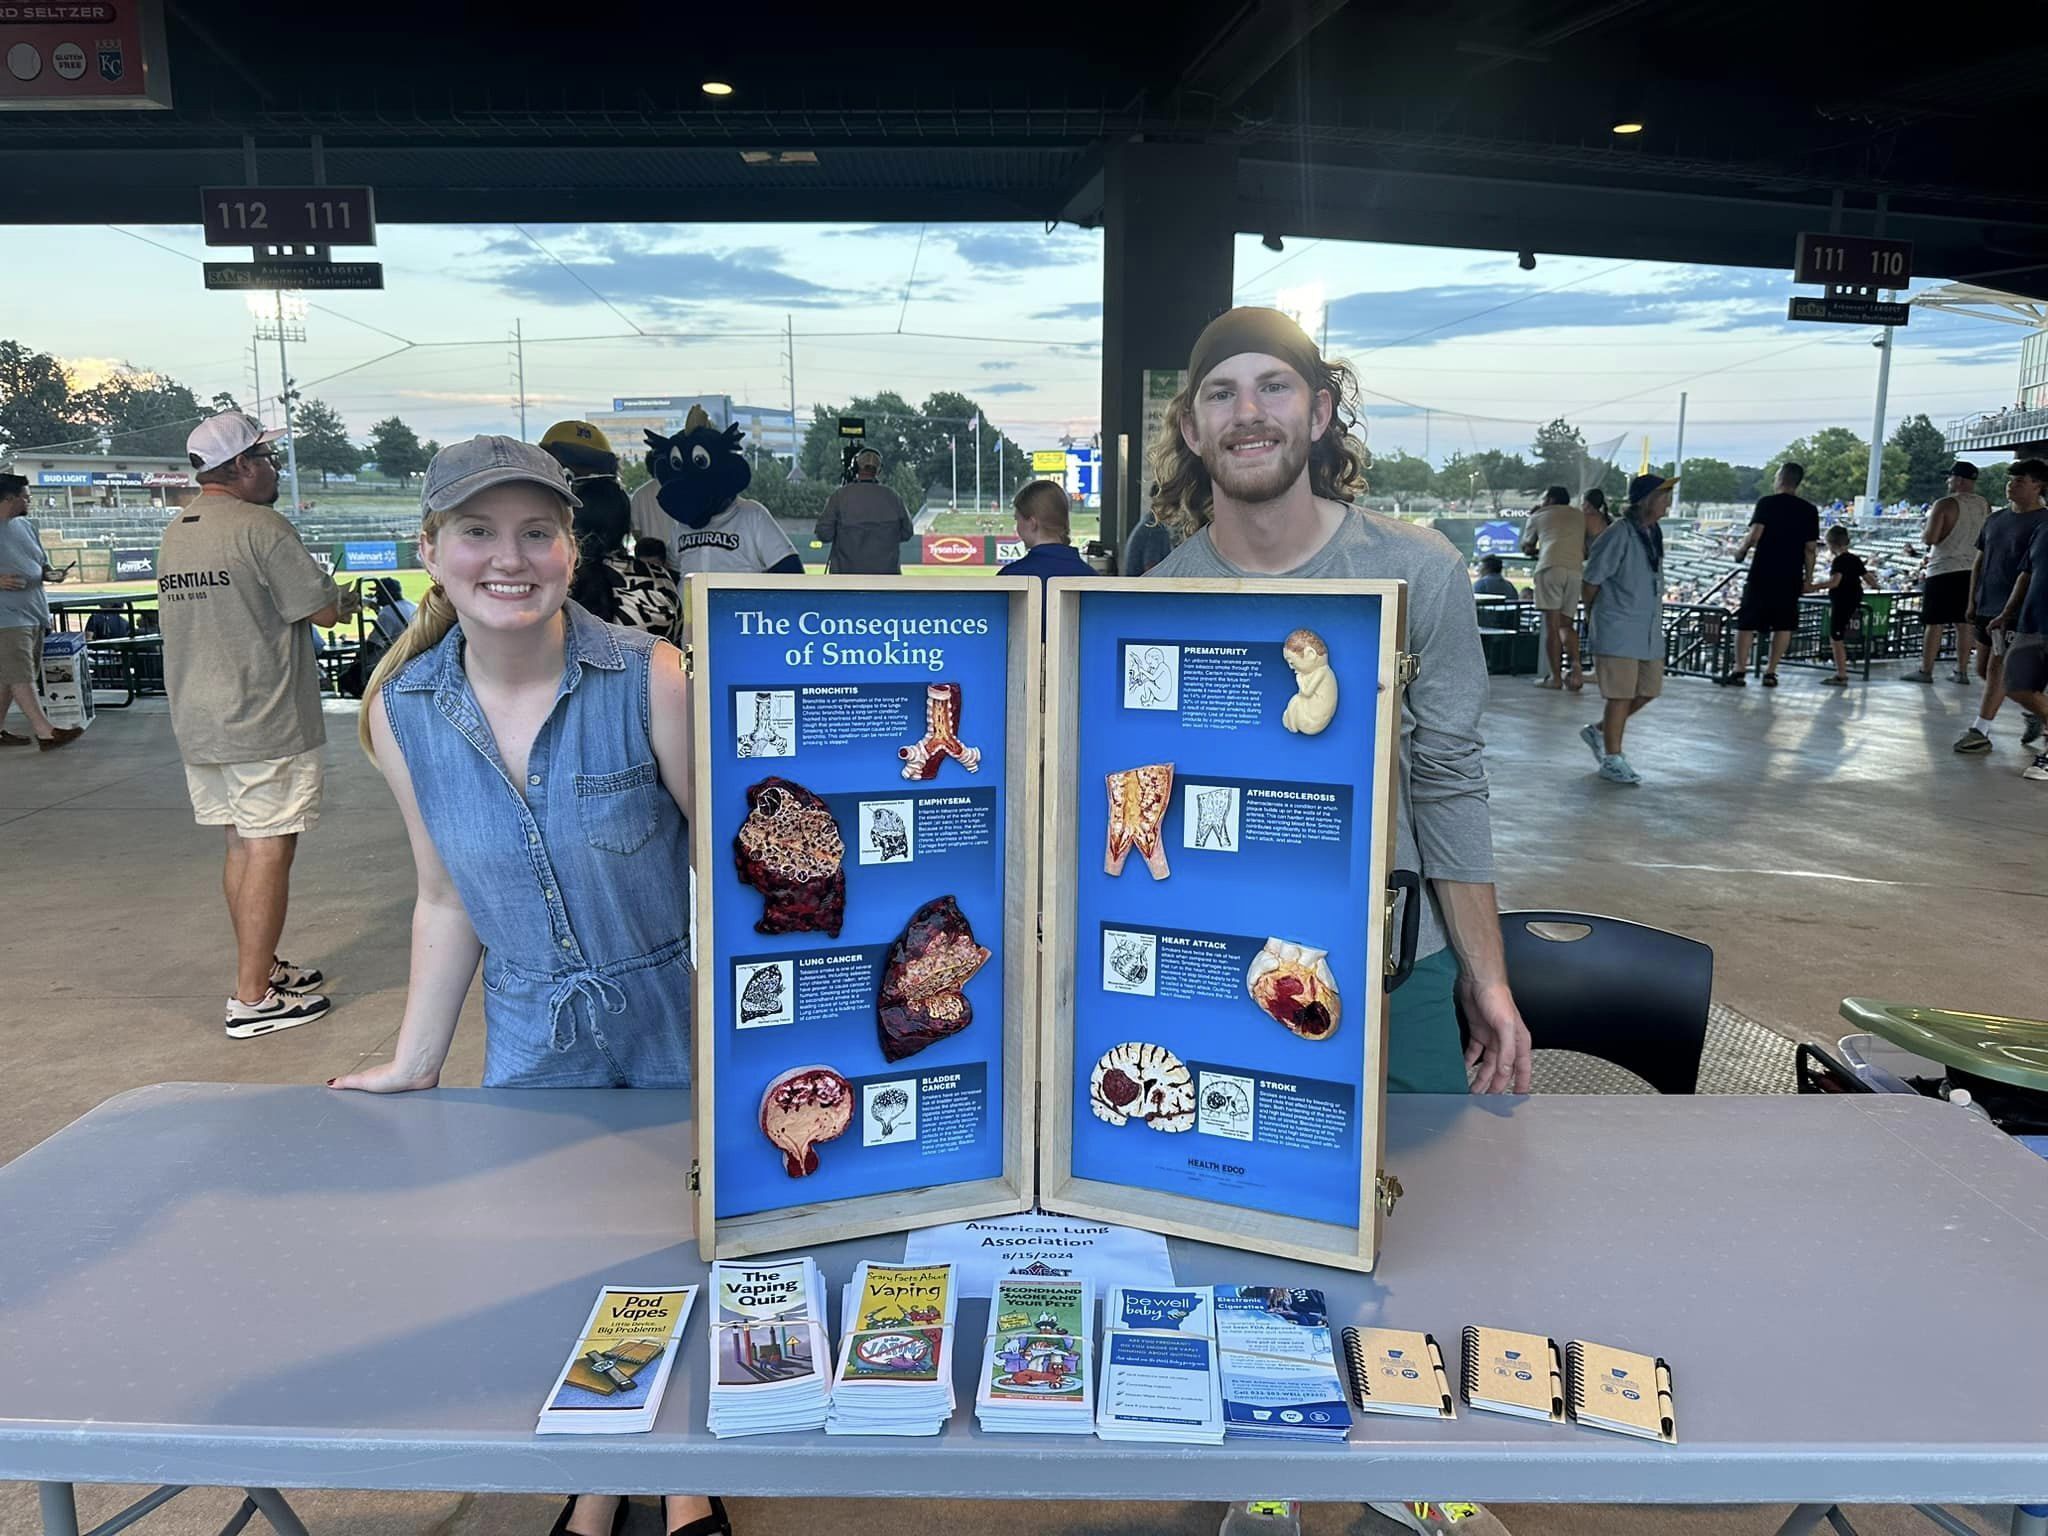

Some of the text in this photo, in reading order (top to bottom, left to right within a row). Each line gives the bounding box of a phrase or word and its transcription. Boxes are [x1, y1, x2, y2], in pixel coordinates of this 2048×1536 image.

[24, 7, 104, 18] SELTZER
[101, 55, 121, 75] KC
[217, 202, 351, 229] 112 111
[1814, 247, 1903, 275] 111 110
[43, 474, 87, 483] BUD LIGHT
[348, 552, 383, 561] Walmart
[735, 611, 988, 642] The Consequences
[785, 641, 944, 671] of Smoking
[1184, 647, 1248, 655] PREMATURITY
[802, 687, 858, 695] BRONCHITIS
[919, 797, 971, 806] EMPHYSEMA
[1247, 789, 1336, 802] ATHEROSCLEROSIS
[1161, 936, 1227, 950] HEART ATTACK
[800, 955, 863, 966] LUNG CANCER
[922, 1074, 960, 1085] BLADDER
[922, 1082, 956, 1092] CANCER
[1260, 1080, 1297, 1092] STROKE
[1187, 1158, 1245, 1175] HEALTH EDCO
[966, 1223, 1057, 1234] American
[981, 1236, 1094, 1247] Association
[1002, 1251, 1073, 1260] 8/15/2024
[742, 1272, 780, 1282] The
[867, 1272, 948, 1282] Scary Facts About
[726, 1280, 799, 1296] Vaping
[870, 1283, 941, 1301] Vaping
[625, 1296, 663, 1308] Pod
[738, 1294, 787, 1306] Quiz
[1127, 1295, 1189, 1308] be well
[612, 1307, 669, 1321] Vapes
[1126, 1305, 1162, 1320] baby
[615, 1325, 666, 1334] Problems!
